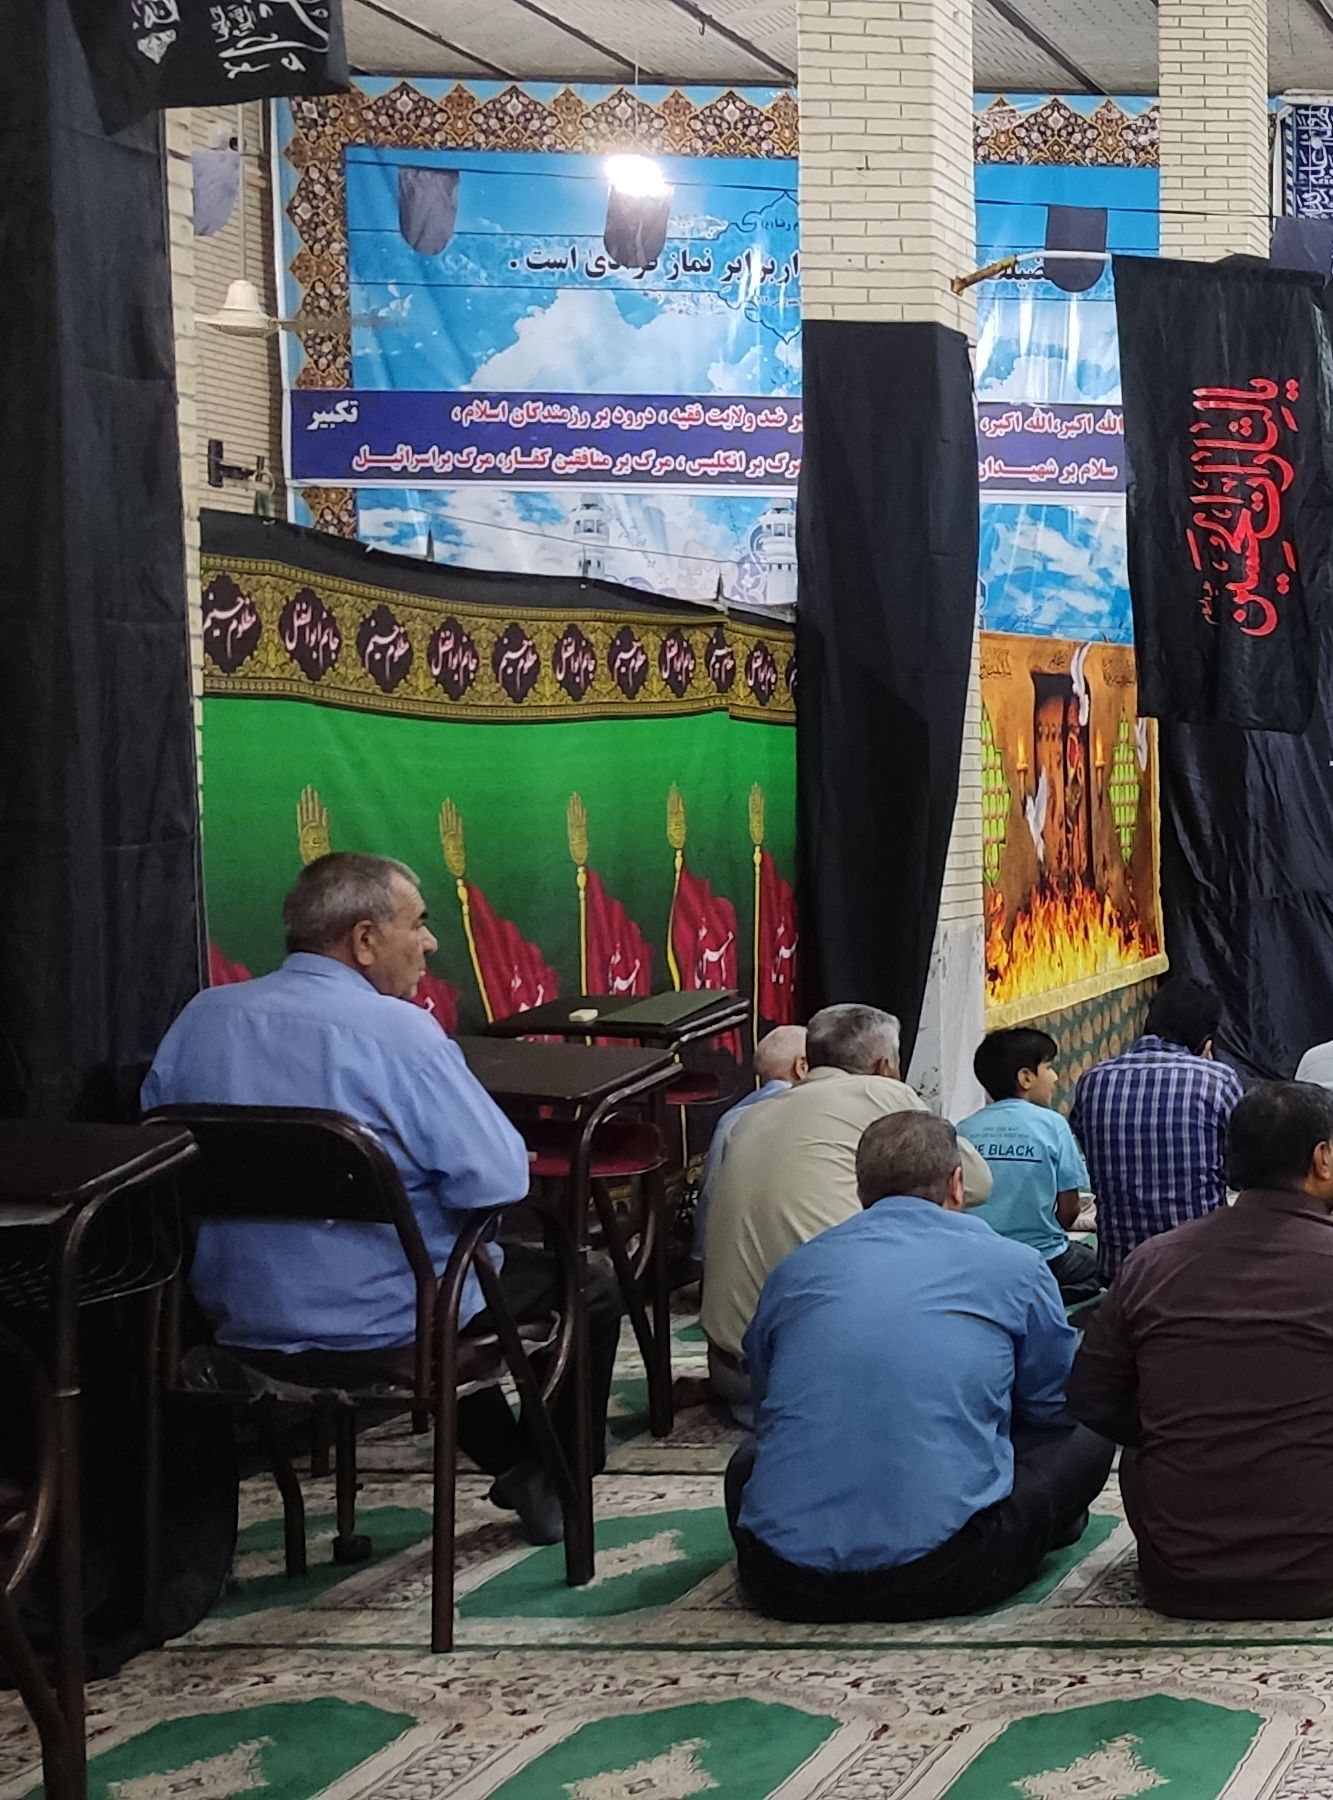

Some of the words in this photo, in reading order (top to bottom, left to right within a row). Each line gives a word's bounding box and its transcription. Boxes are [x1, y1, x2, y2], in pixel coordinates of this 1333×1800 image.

[525, 245, 577, 272] است
[666, 248, 714, 281] نماز
[306, 400, 359, 430] تکبیر
[508, 401, 591, 429] رزمندگان
[591, 406, 611, 429] بر
[612, 405, 656, 429] درود
[705, 404, 757, 432] ولایت
[757, 406, 788, 427] ضد
[552, 446, 611, 474] منافقین
[612, 454, 632, 475] بر
[745, 456, 764, 478] بر
[1079, 457, 1119, 481] سلام
[1060, 463, 1079, 483] بر
[988, 1143, 1035, 1158] BLACK
